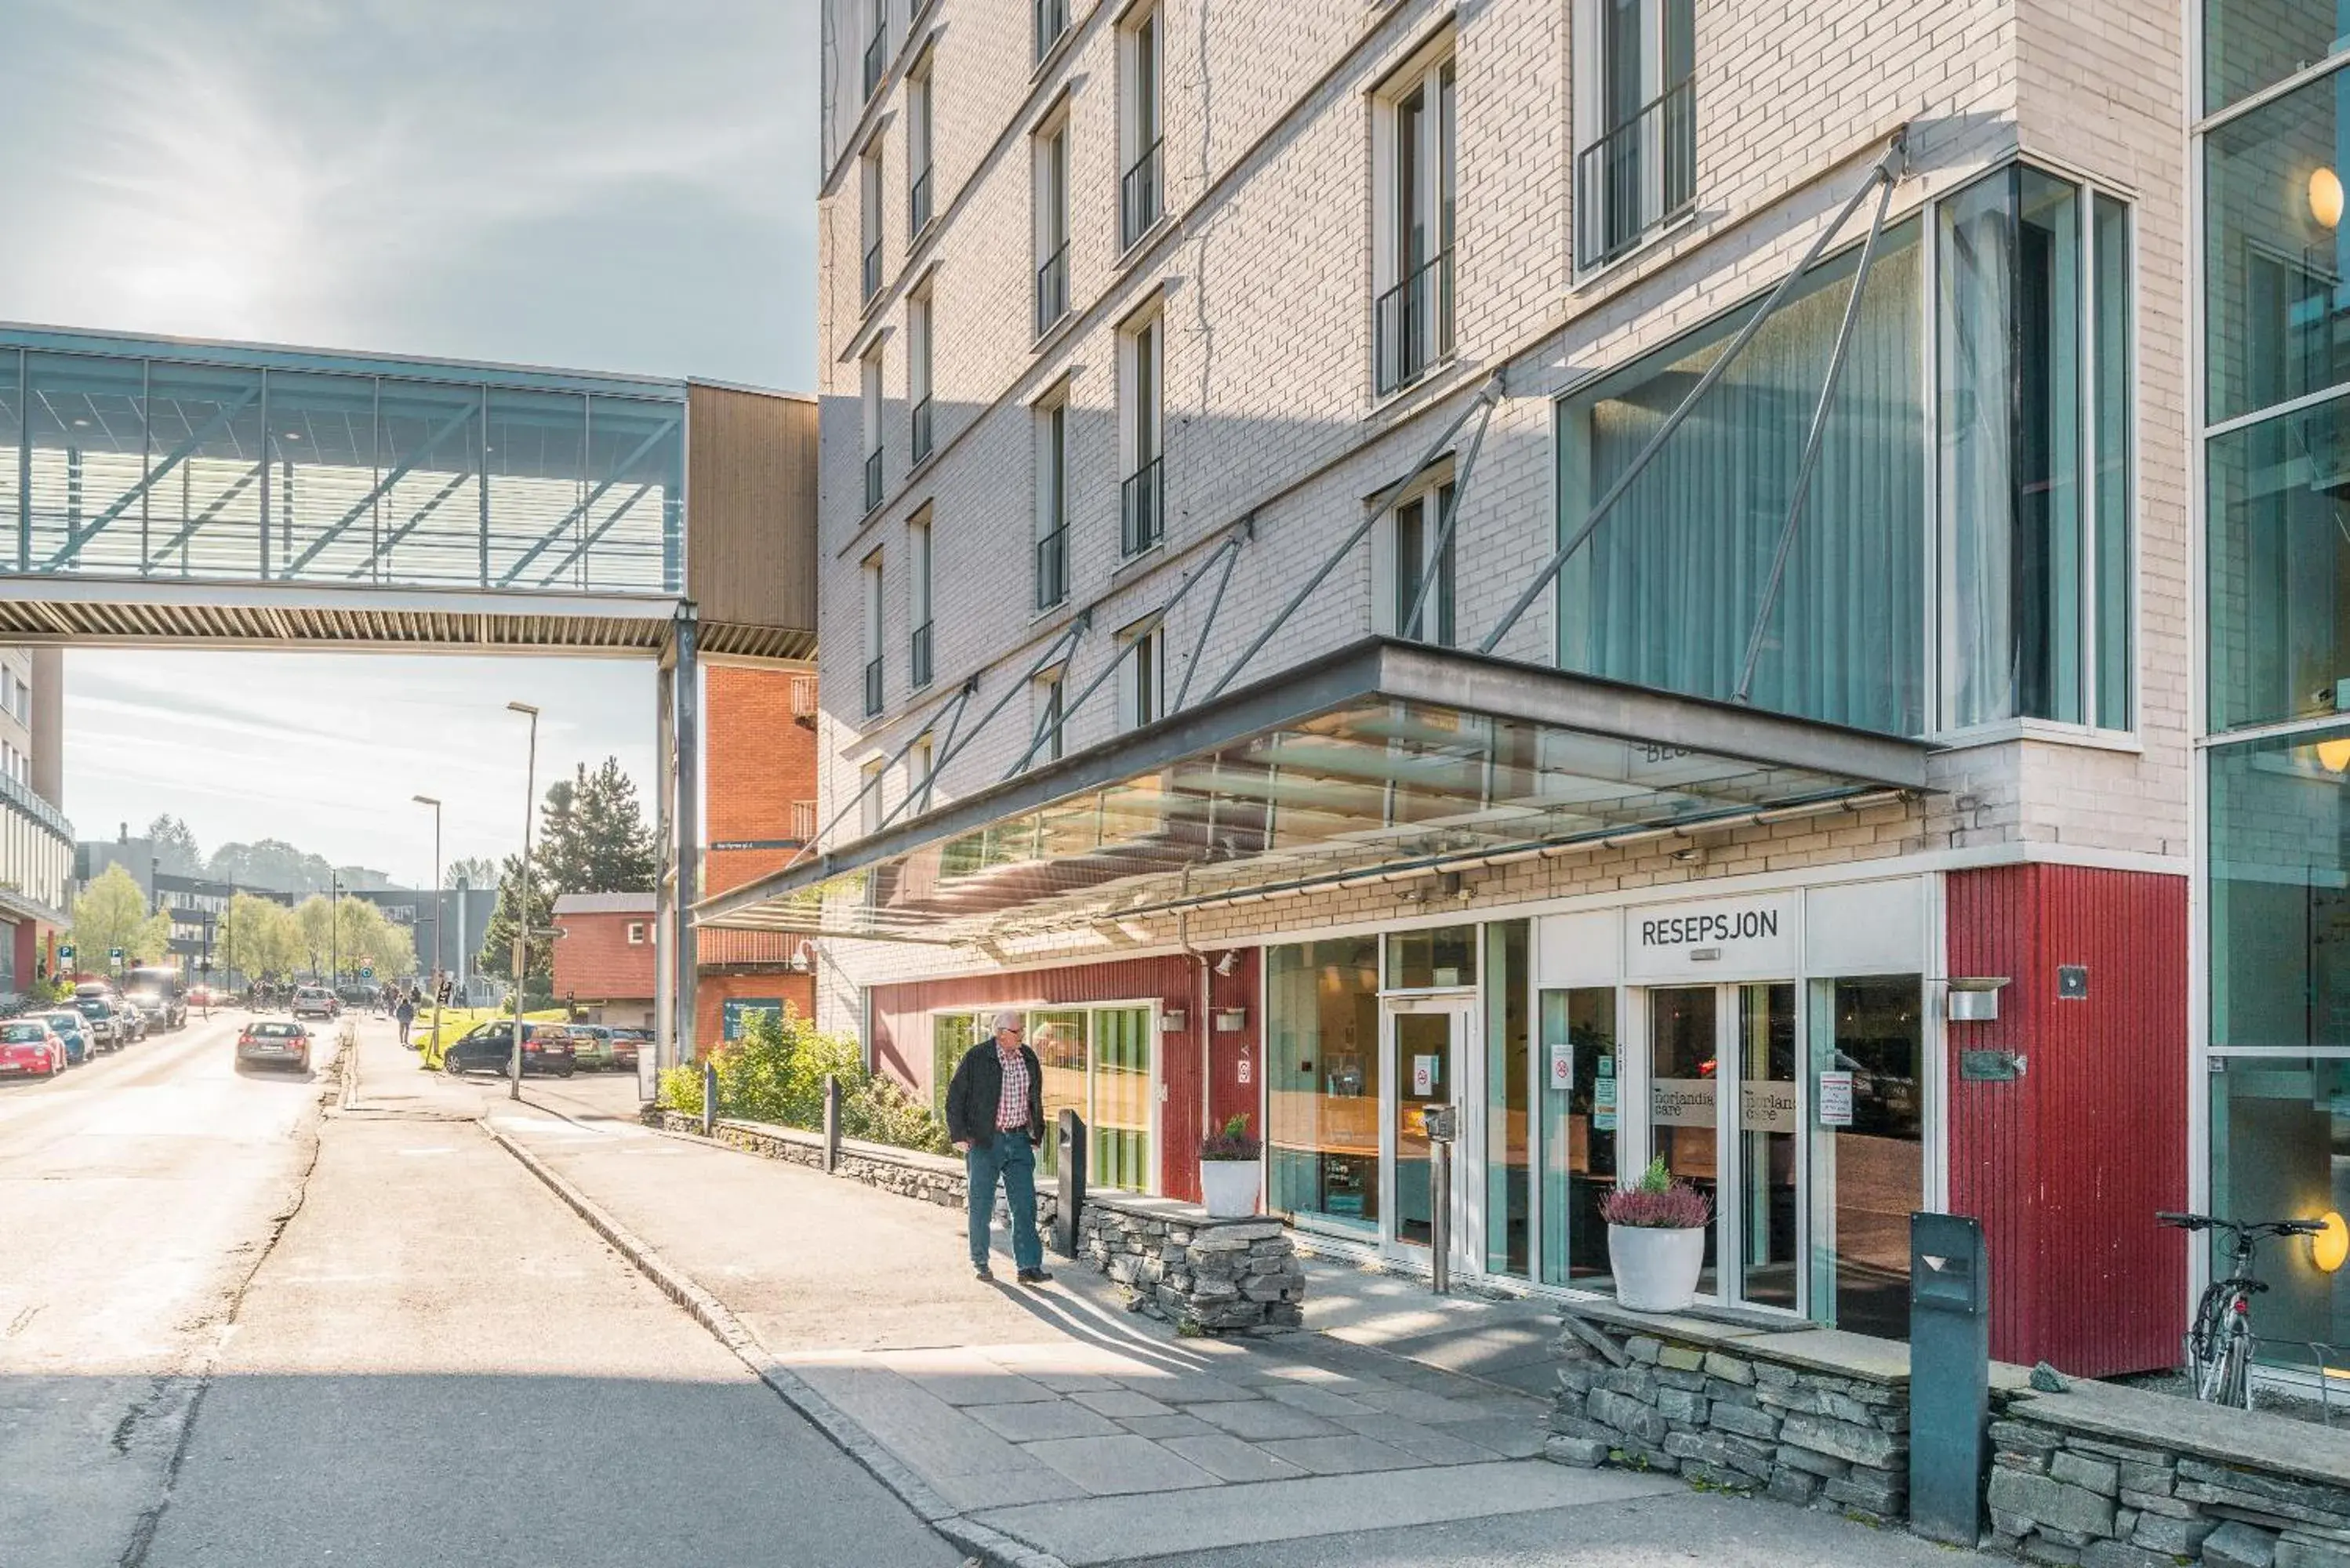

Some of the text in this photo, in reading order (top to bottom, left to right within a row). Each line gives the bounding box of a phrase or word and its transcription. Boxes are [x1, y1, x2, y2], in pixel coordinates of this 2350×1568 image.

[1642, 909, 1778, 946] RESEPSJON
[1654, 1105, 1682, 1116] care
[1746, 1109, 1777, 1121] cre
